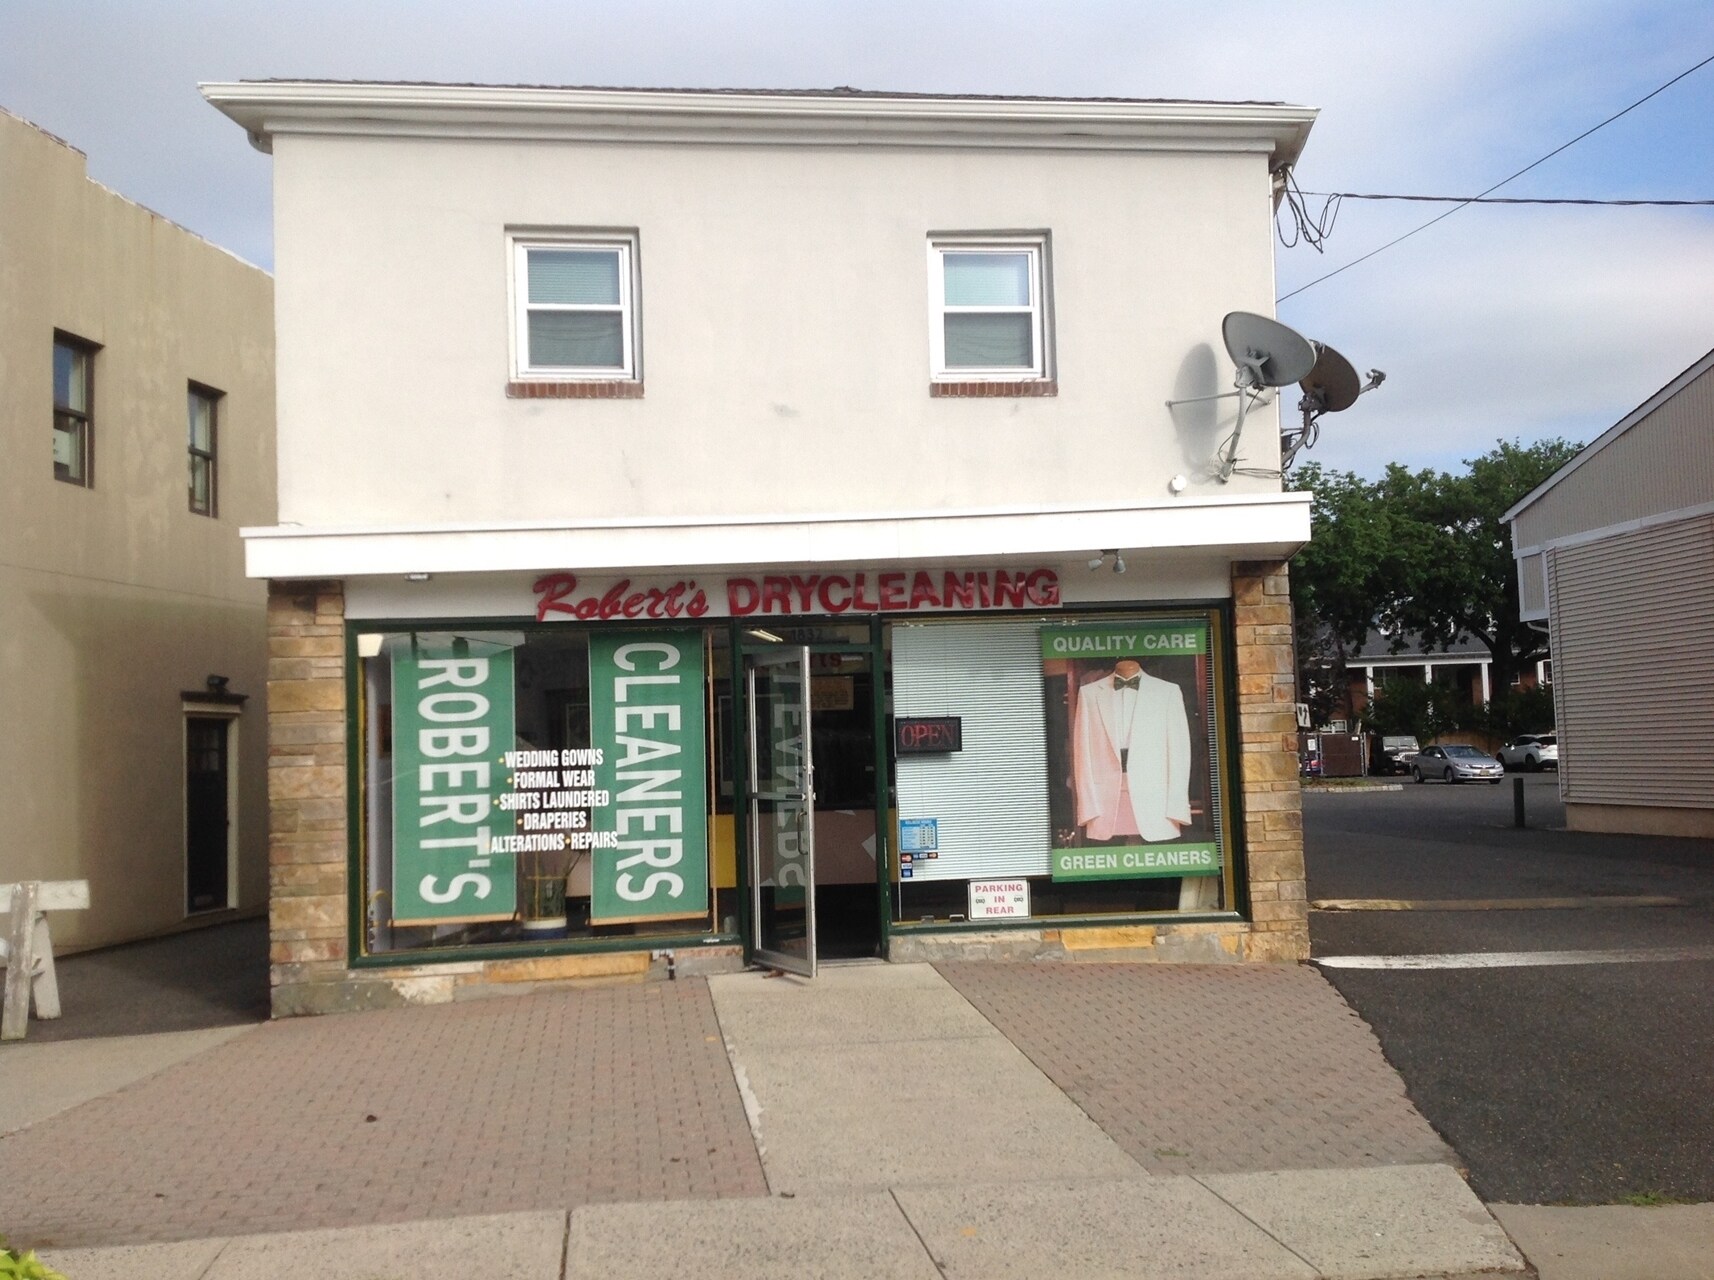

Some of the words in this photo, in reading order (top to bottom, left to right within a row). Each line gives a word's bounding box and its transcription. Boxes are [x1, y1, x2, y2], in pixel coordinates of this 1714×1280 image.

[533, 571, 710, 621] Robert's
[727, 568, 1060, 615] DRYCLEANING
[1053, 635, 1137, 652] QUALITY
[1143, 634, 1197, 649] CARE
[901, 723, 955, 747] OPEN
[504, 750, 559, 768] WEDDING
[561, 749, 604, 766] GOWNS
[417, 658, 492, 904] ROBERT'S
[513, 771, 560, 789] FORMAL
[562, 770, 596, 787] WEAR
[613, 642, 684, 902] CLEANERS
[499, 792, 540, 810] SHIRTS
[542, 790, 609, 808] LAUNDERED
[523, 811, 587, 830] DRAPERIES
[491, 833, 565, 853] ALTERATIONS
[571, 831, 618, 849] REPAIRS
[1060, 854, 1118, 871] GREEN
[1123, 850, 1212, 868] CLEANERS
[975, 883, 1023, 893] PARKING
[994, 895, 1006, 903] IN
[986, 906, 1015, 915] REAR
